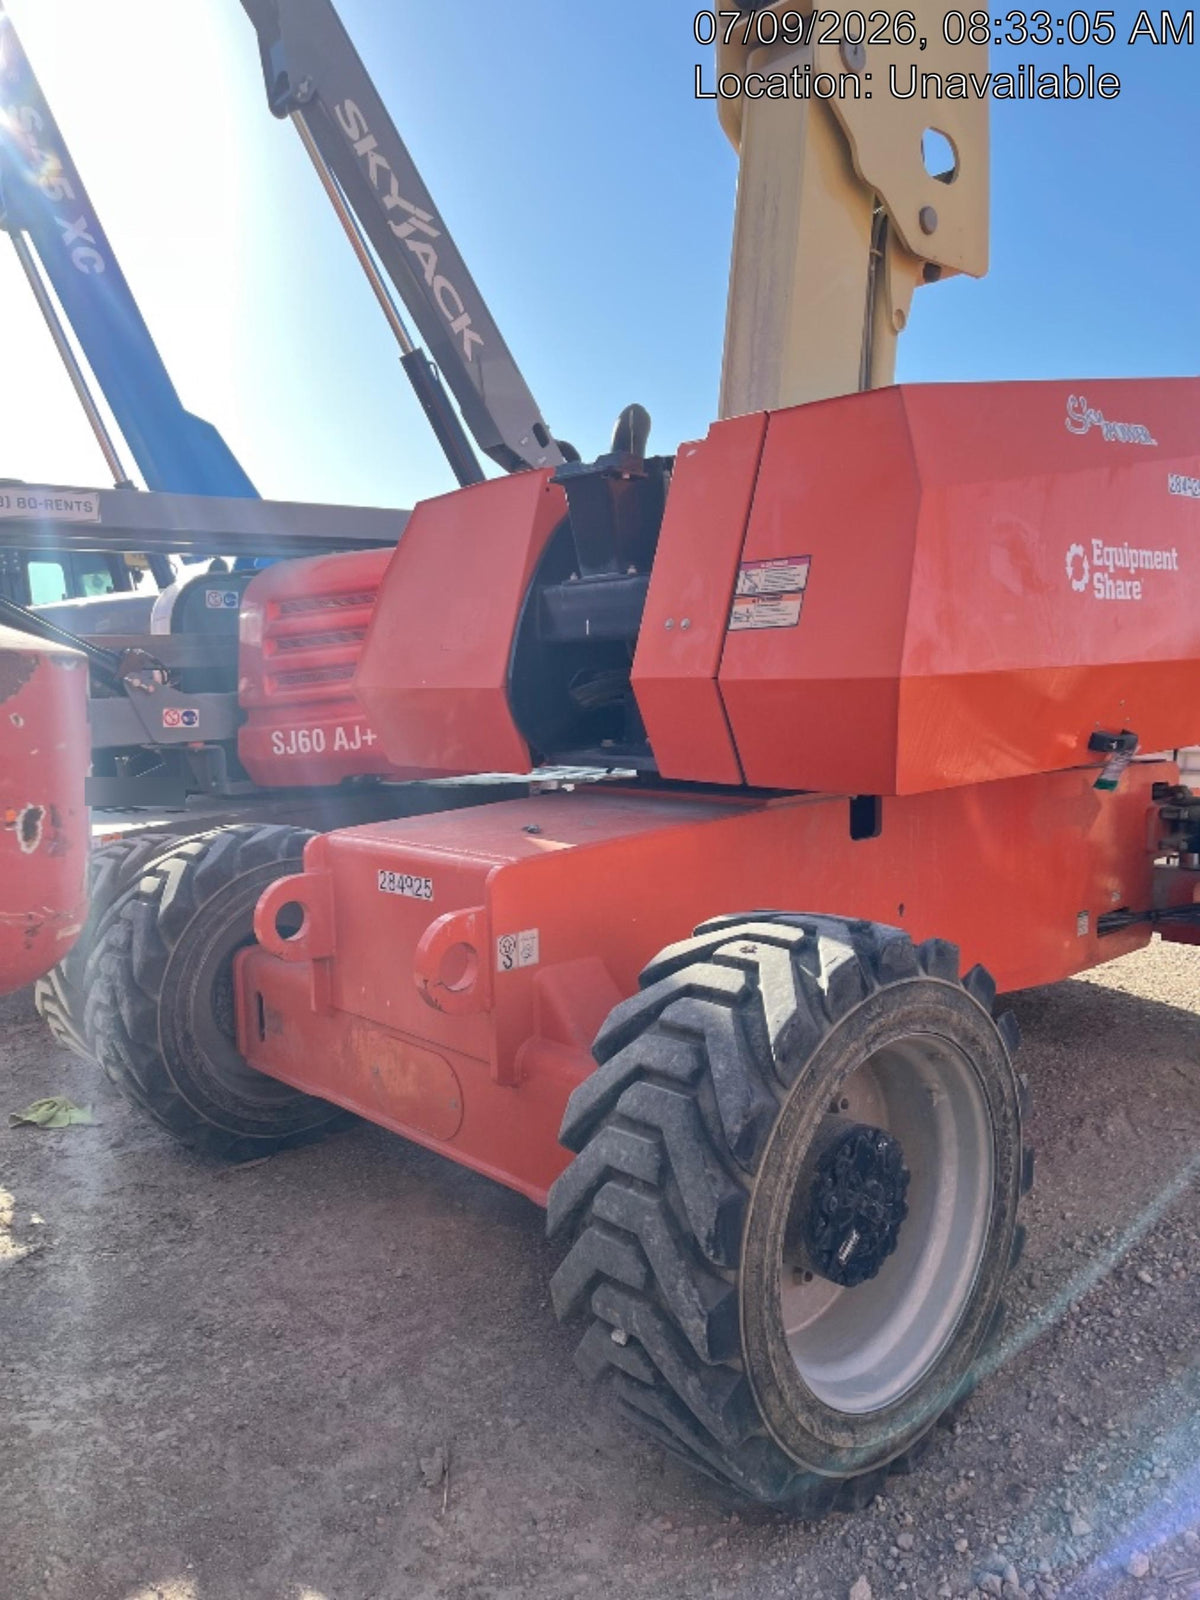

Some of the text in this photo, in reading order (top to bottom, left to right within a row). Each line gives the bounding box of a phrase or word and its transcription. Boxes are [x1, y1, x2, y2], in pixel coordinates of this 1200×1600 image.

[54, 214, 105, 275] XC
[334, 98, 484, 362] SKYJACK
[1091, 538, 1179, 574] Equipment
[1093, 572, 1142, 600] Share
[271, 725, 377, 755] SJ60 AJ+
[380, 870, 433, 899] 284925
